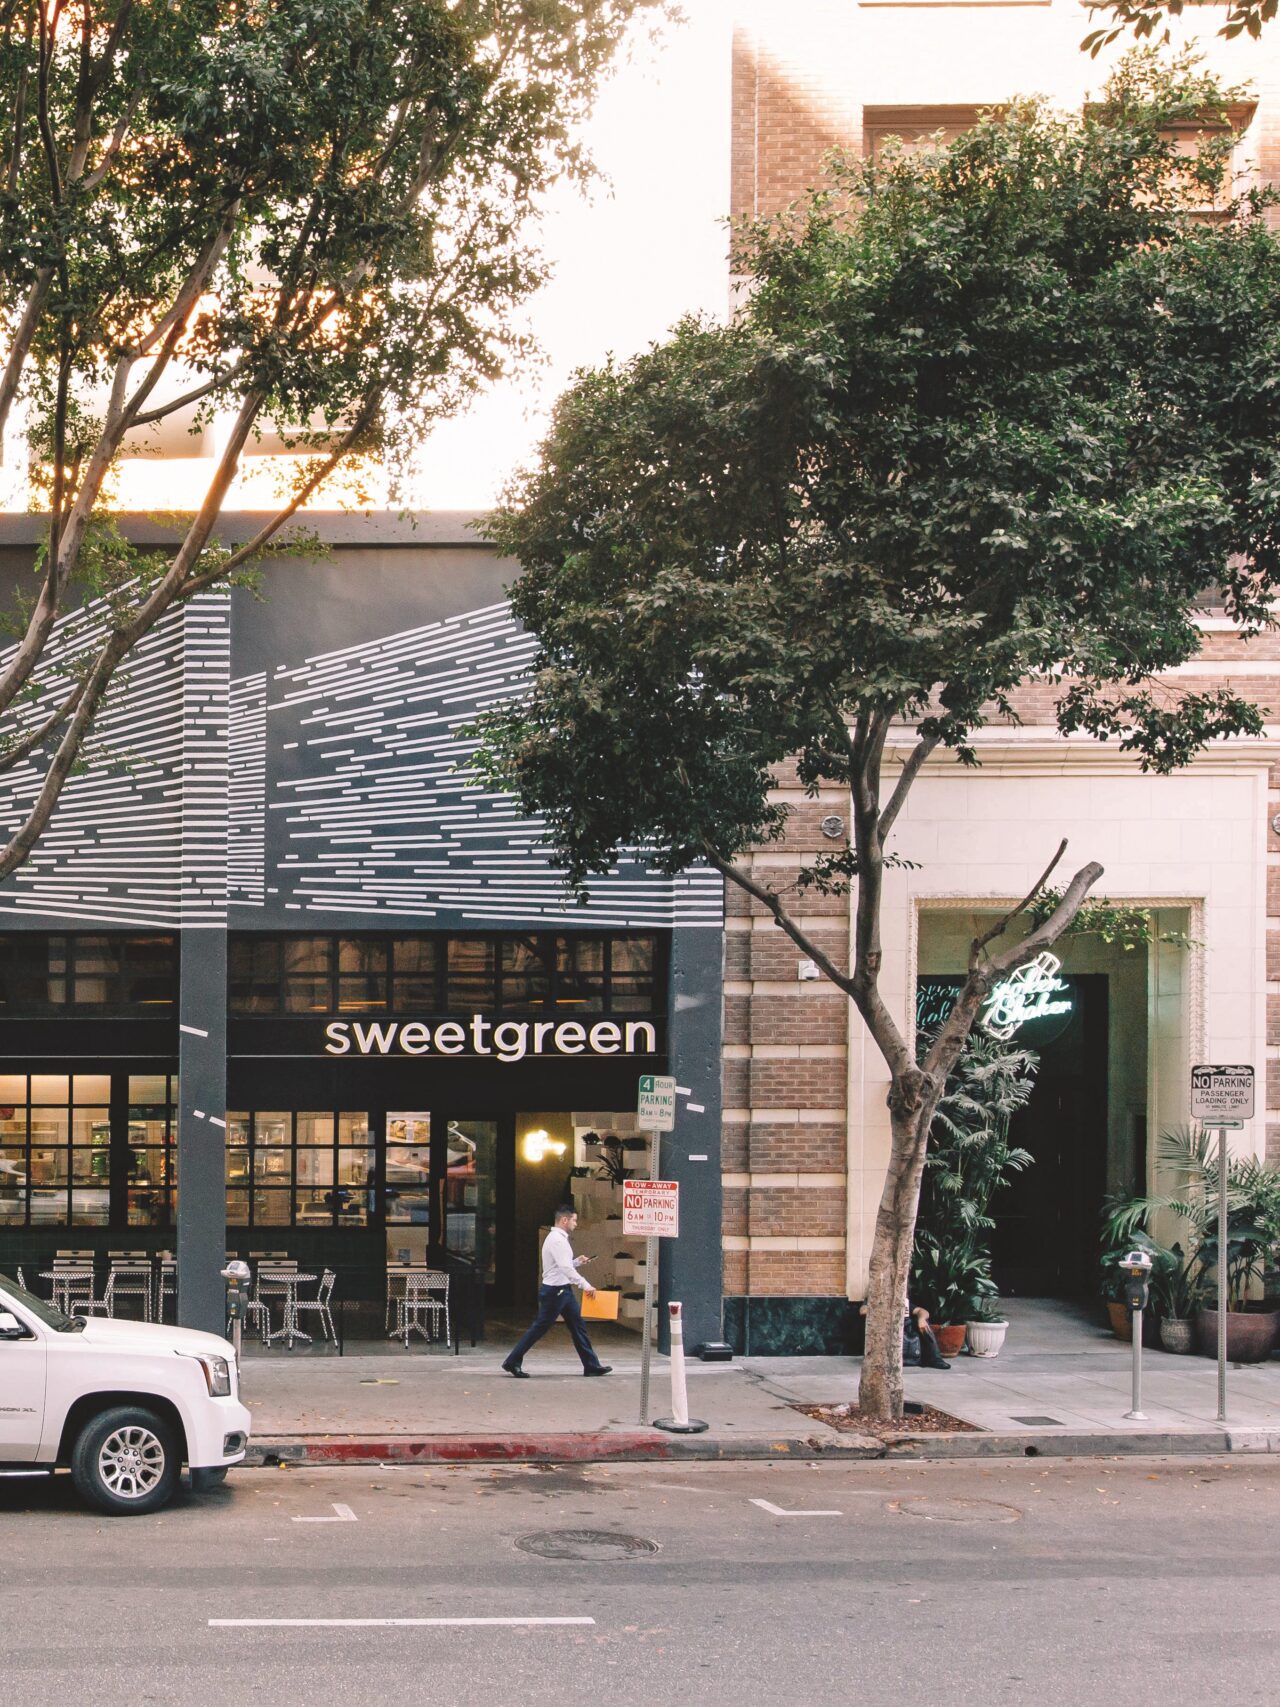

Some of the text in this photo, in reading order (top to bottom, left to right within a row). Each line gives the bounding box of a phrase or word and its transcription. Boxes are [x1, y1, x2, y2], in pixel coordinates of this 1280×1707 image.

[325, 1014, 656, 1062] sweetgreen
[642, 1078, 651, 1091] 4
[1193, 1076, 1252, 1089] NO PARKING
[640, 1094, 673, 1106] PARKING
[626, 1195, 675, 1209] NO PARKING
